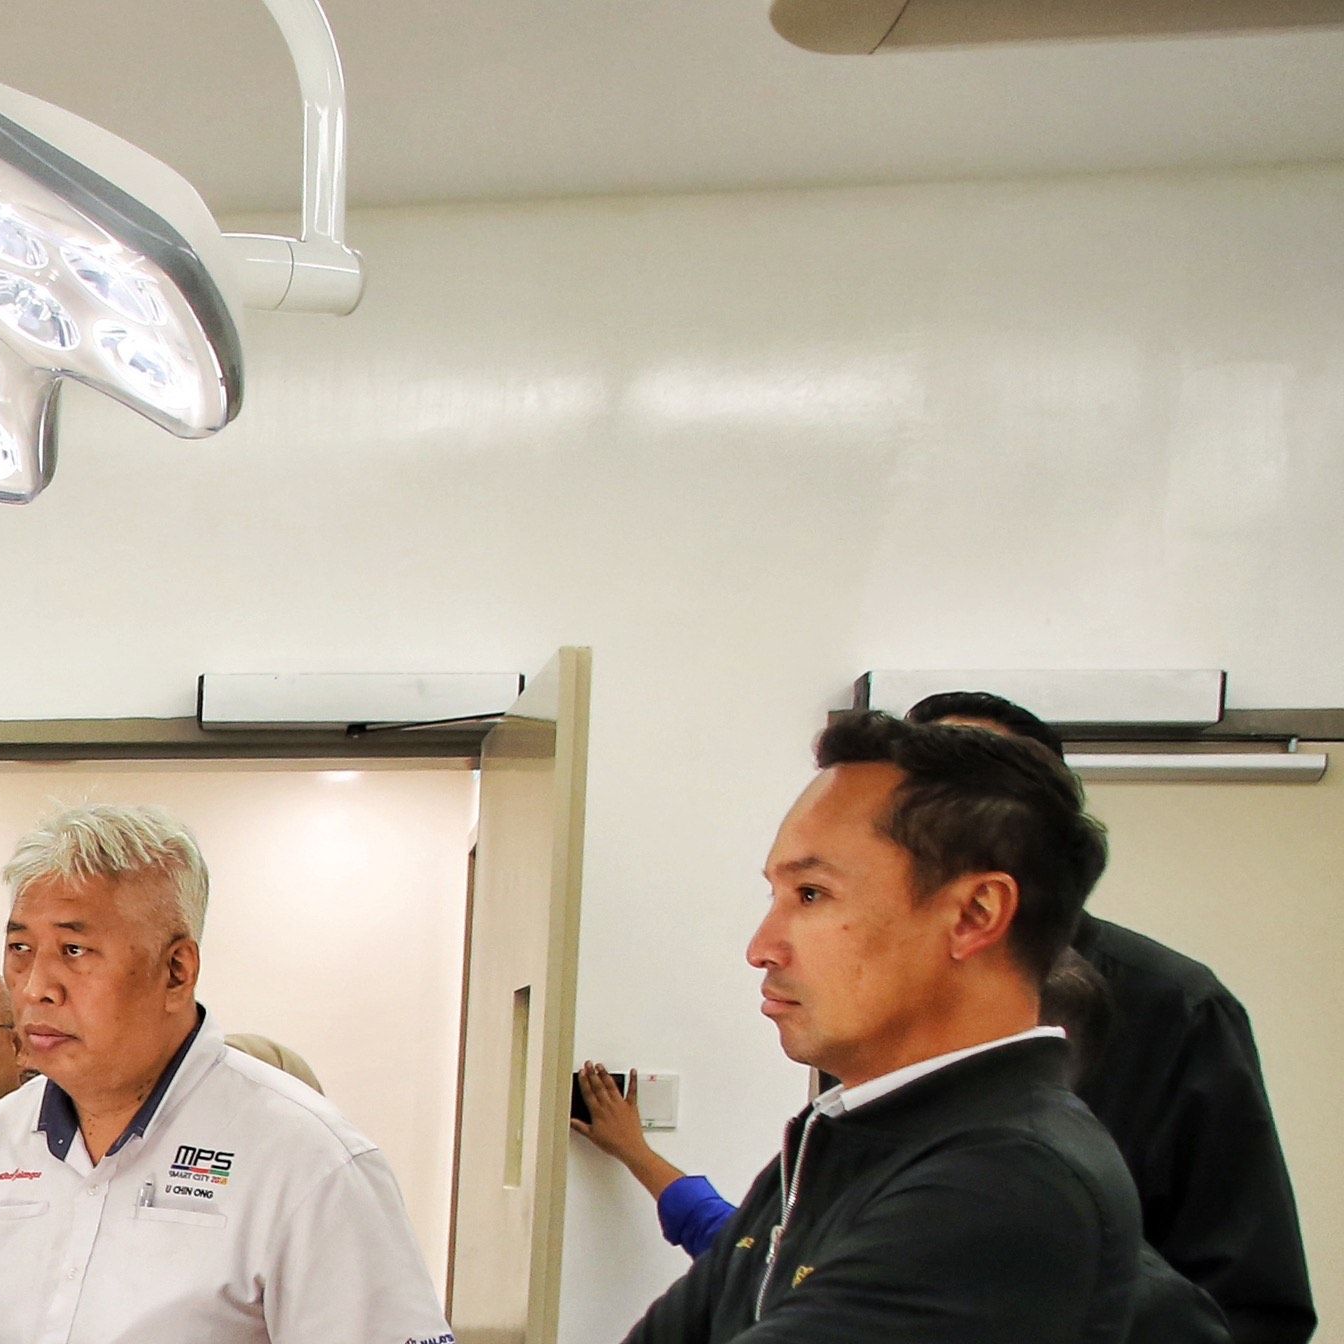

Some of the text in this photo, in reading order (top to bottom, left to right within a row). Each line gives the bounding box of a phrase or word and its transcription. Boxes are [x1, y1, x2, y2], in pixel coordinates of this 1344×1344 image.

[174, 1145, 235, 1170] MPS
[192, 1173, 210, 1182] CITY
[193, 1188, 214, 1199] ONG
